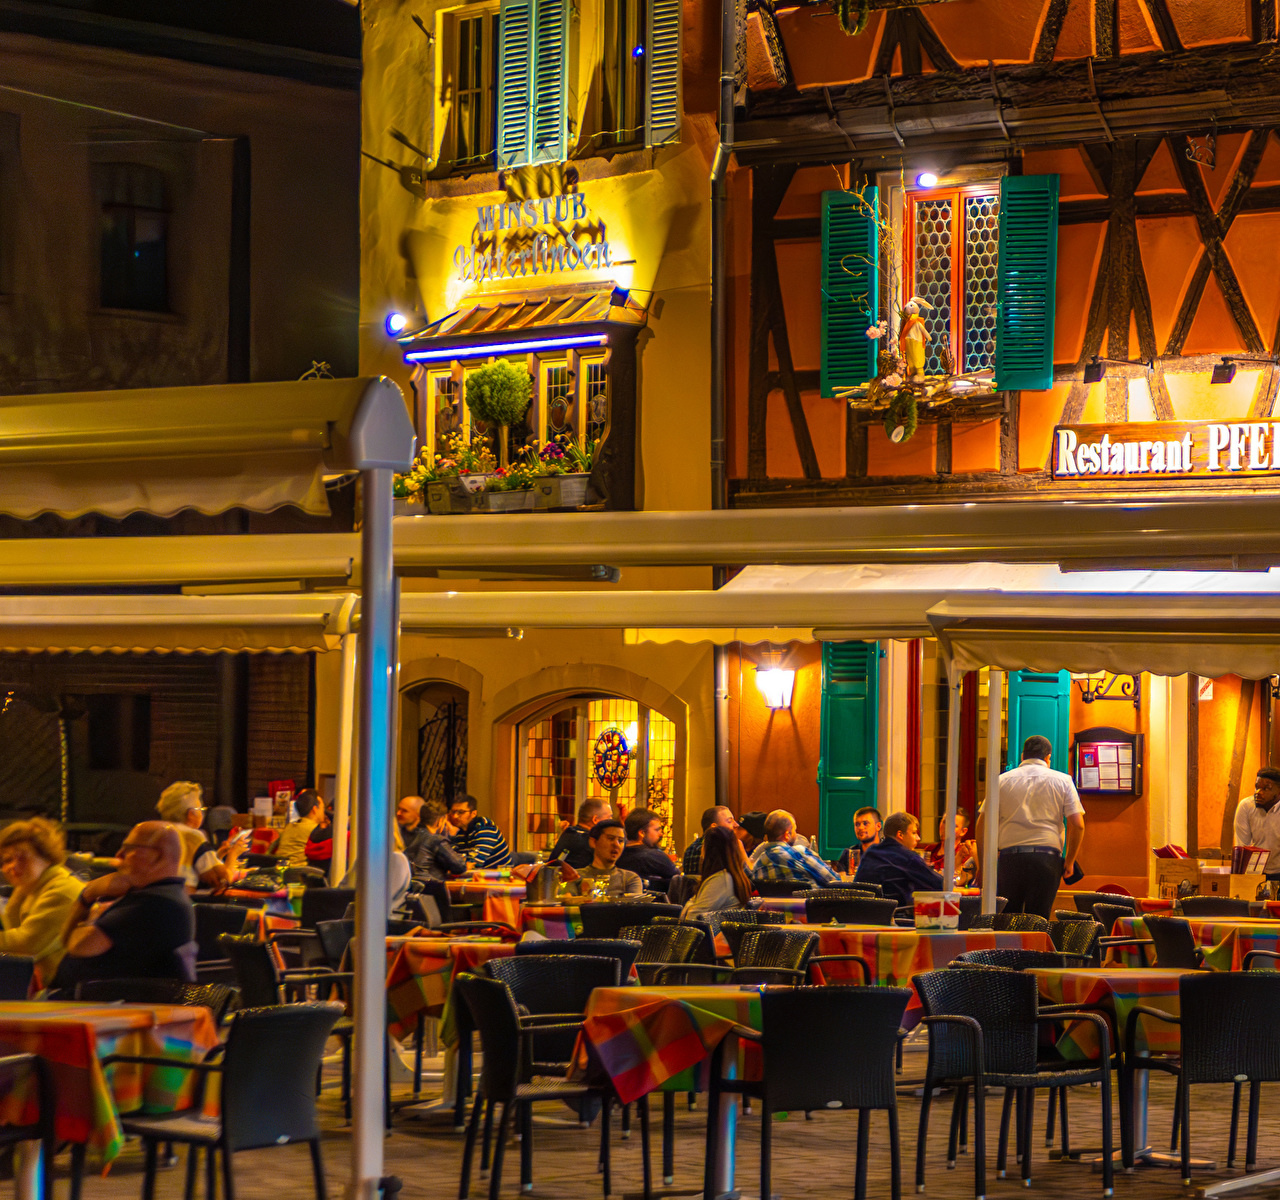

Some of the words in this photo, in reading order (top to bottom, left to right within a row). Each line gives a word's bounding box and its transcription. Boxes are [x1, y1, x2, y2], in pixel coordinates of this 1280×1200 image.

[476, 192, 587, 232] WINSTUB
[453, 230, 613, 283] Unterlinden
[1055, 429, 1194, 476] Restaurant
